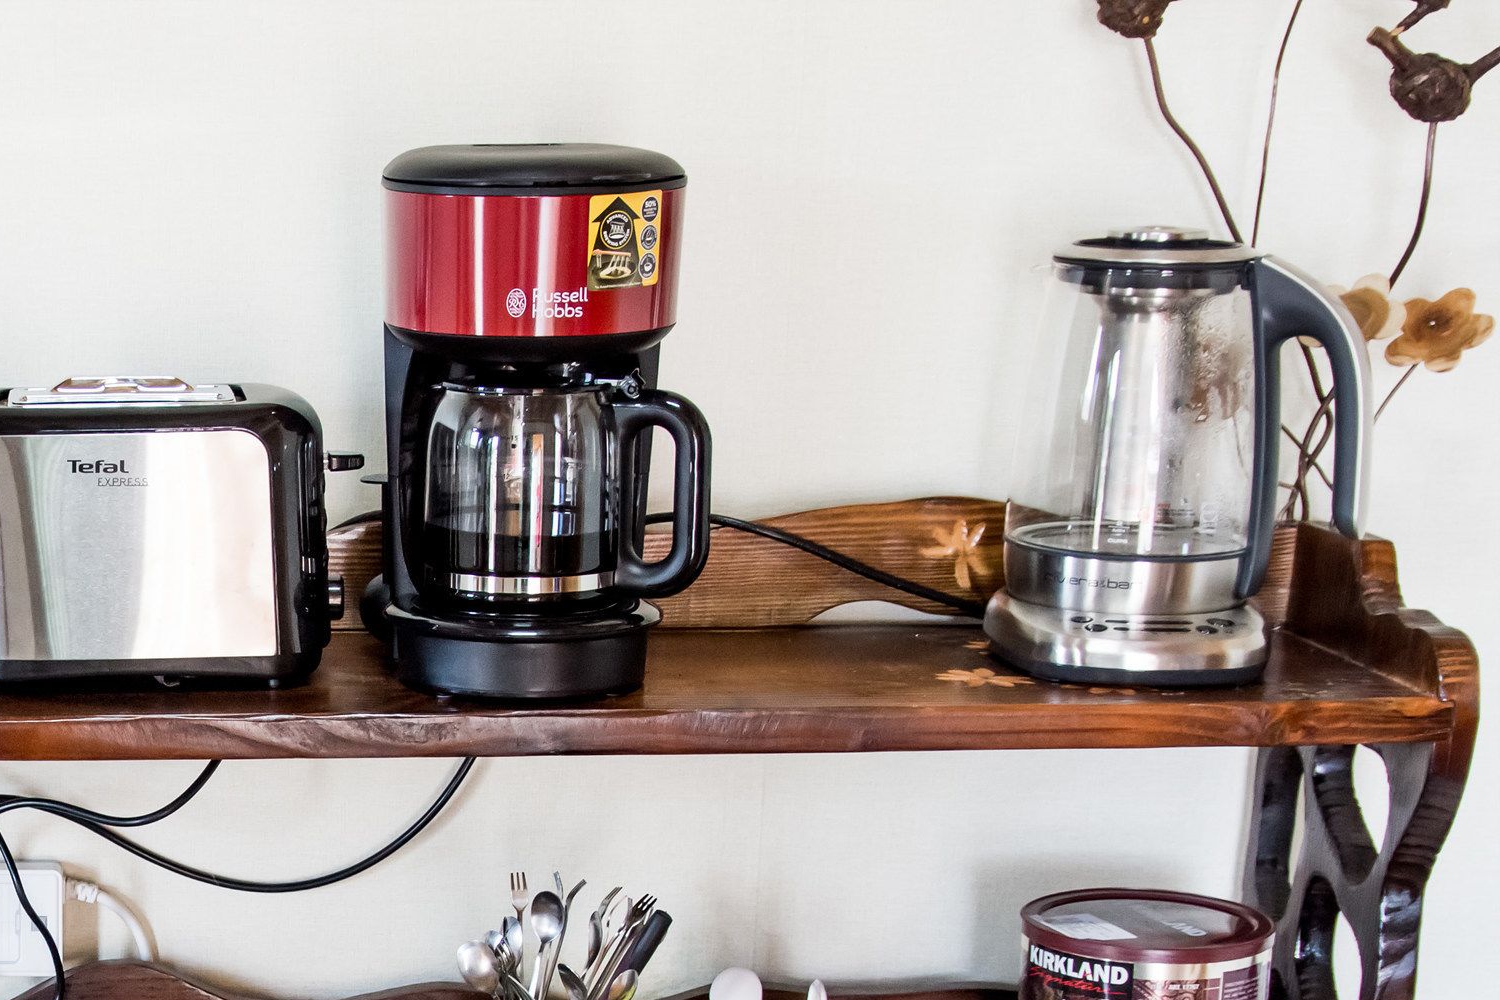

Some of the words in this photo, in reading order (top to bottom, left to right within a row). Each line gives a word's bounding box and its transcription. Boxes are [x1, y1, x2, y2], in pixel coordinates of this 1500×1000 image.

[532, 287, 589, 303] Russell
[532, 303, 583, 319] Hobbs
[66, 459, 129, 474] Tefal
[97, 477, 148, 487] EXPRESS
[1030, 945, 1129, 985] KIRKLAND
